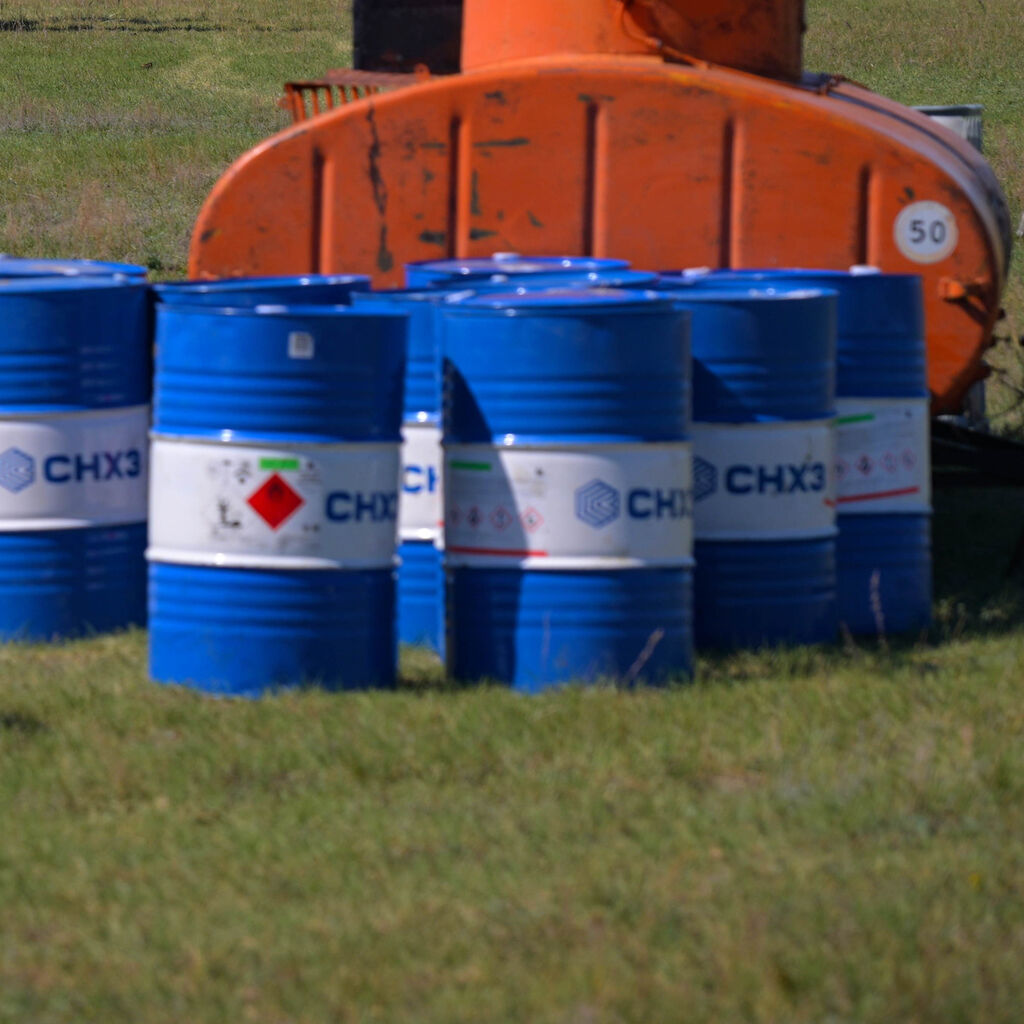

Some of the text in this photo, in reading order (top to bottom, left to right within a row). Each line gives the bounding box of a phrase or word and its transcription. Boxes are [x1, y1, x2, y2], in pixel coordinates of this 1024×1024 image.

[910, 219, 947, 244] 50
[43, 450, 140, 483] CHX3
[725, 462, 824, 495] CHX3
